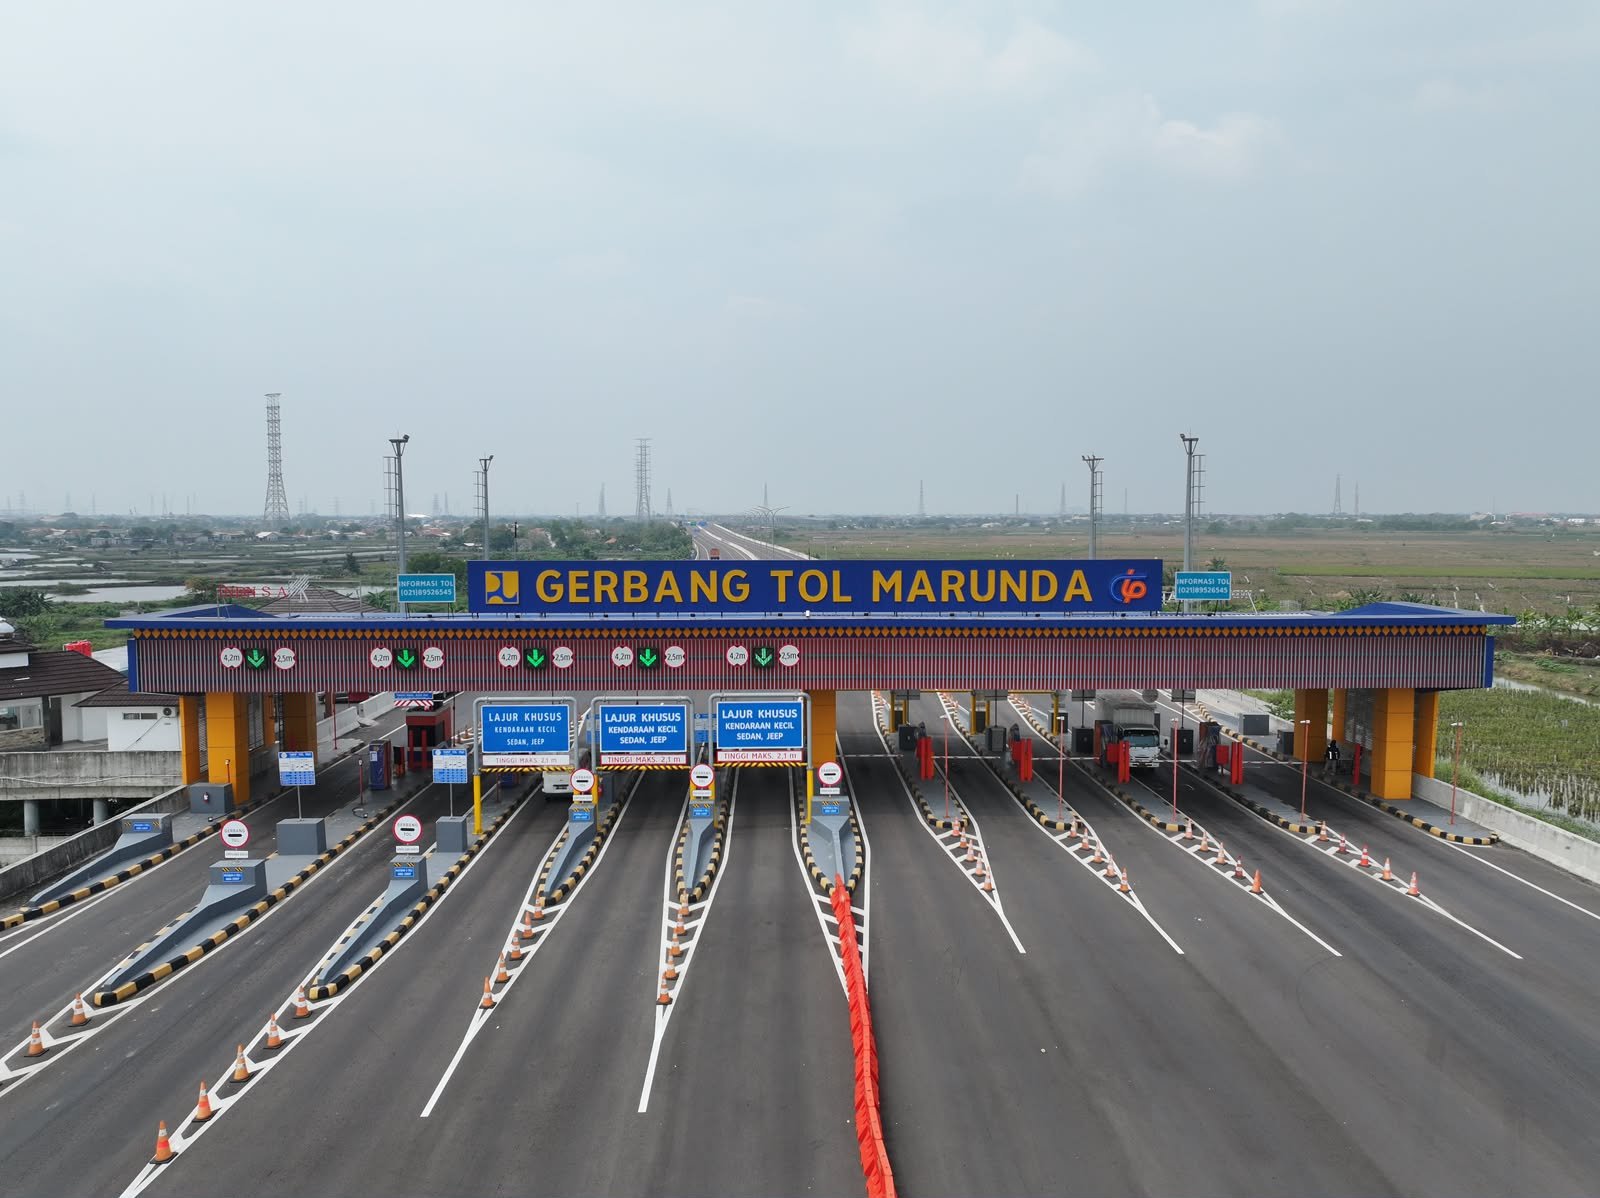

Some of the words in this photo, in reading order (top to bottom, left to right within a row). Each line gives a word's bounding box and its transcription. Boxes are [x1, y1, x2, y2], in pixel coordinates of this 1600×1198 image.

[535, 568, 751, 604] GERBANG
[771, 569, 852, 603] TOL
[872, 569, 1093, 603] MARUNDA
[1178, 586, 1228, 594] (021)89526545
[224, 654, 240, 662] 4,2m
[277, 654, 293, 662] 2,5m
[374, 654, 390, 662] 4,2m
[426, 654, 441, 662] 2,5m
[502, 654, 518, 662] 4,2m
[555, 654, 570, 662] 2,5m
[614, 653, 631, 661] 4,2m
[667, 653, 682, 661] 2,5m
[730, 652, 746, 660] 4,2m
[782, 652, 797, 660] 2,5m
[488, 713, 518, 722] LAJUR
[525, 712, 562, 721] KHUSUS
[605, 713, 636, 722] LAJUR
[641, 713, 681, 722] KHUSUS
[722, 710, 752, 718] LAJUR
[758, 709, 797, 718] KHUSUS
[608, 726, 655, 734] KENDARAAN
[658, 725, 677, 733] KECIL
[726, 722, 770, 730] KENDARAAN
[620, 736, 647, 745] SEDAN,
[650, 736, 667, 744] JEEP
[737, 733, 763, 741] SEDAN,
[507, 738, 529, 746] SEDAN,
